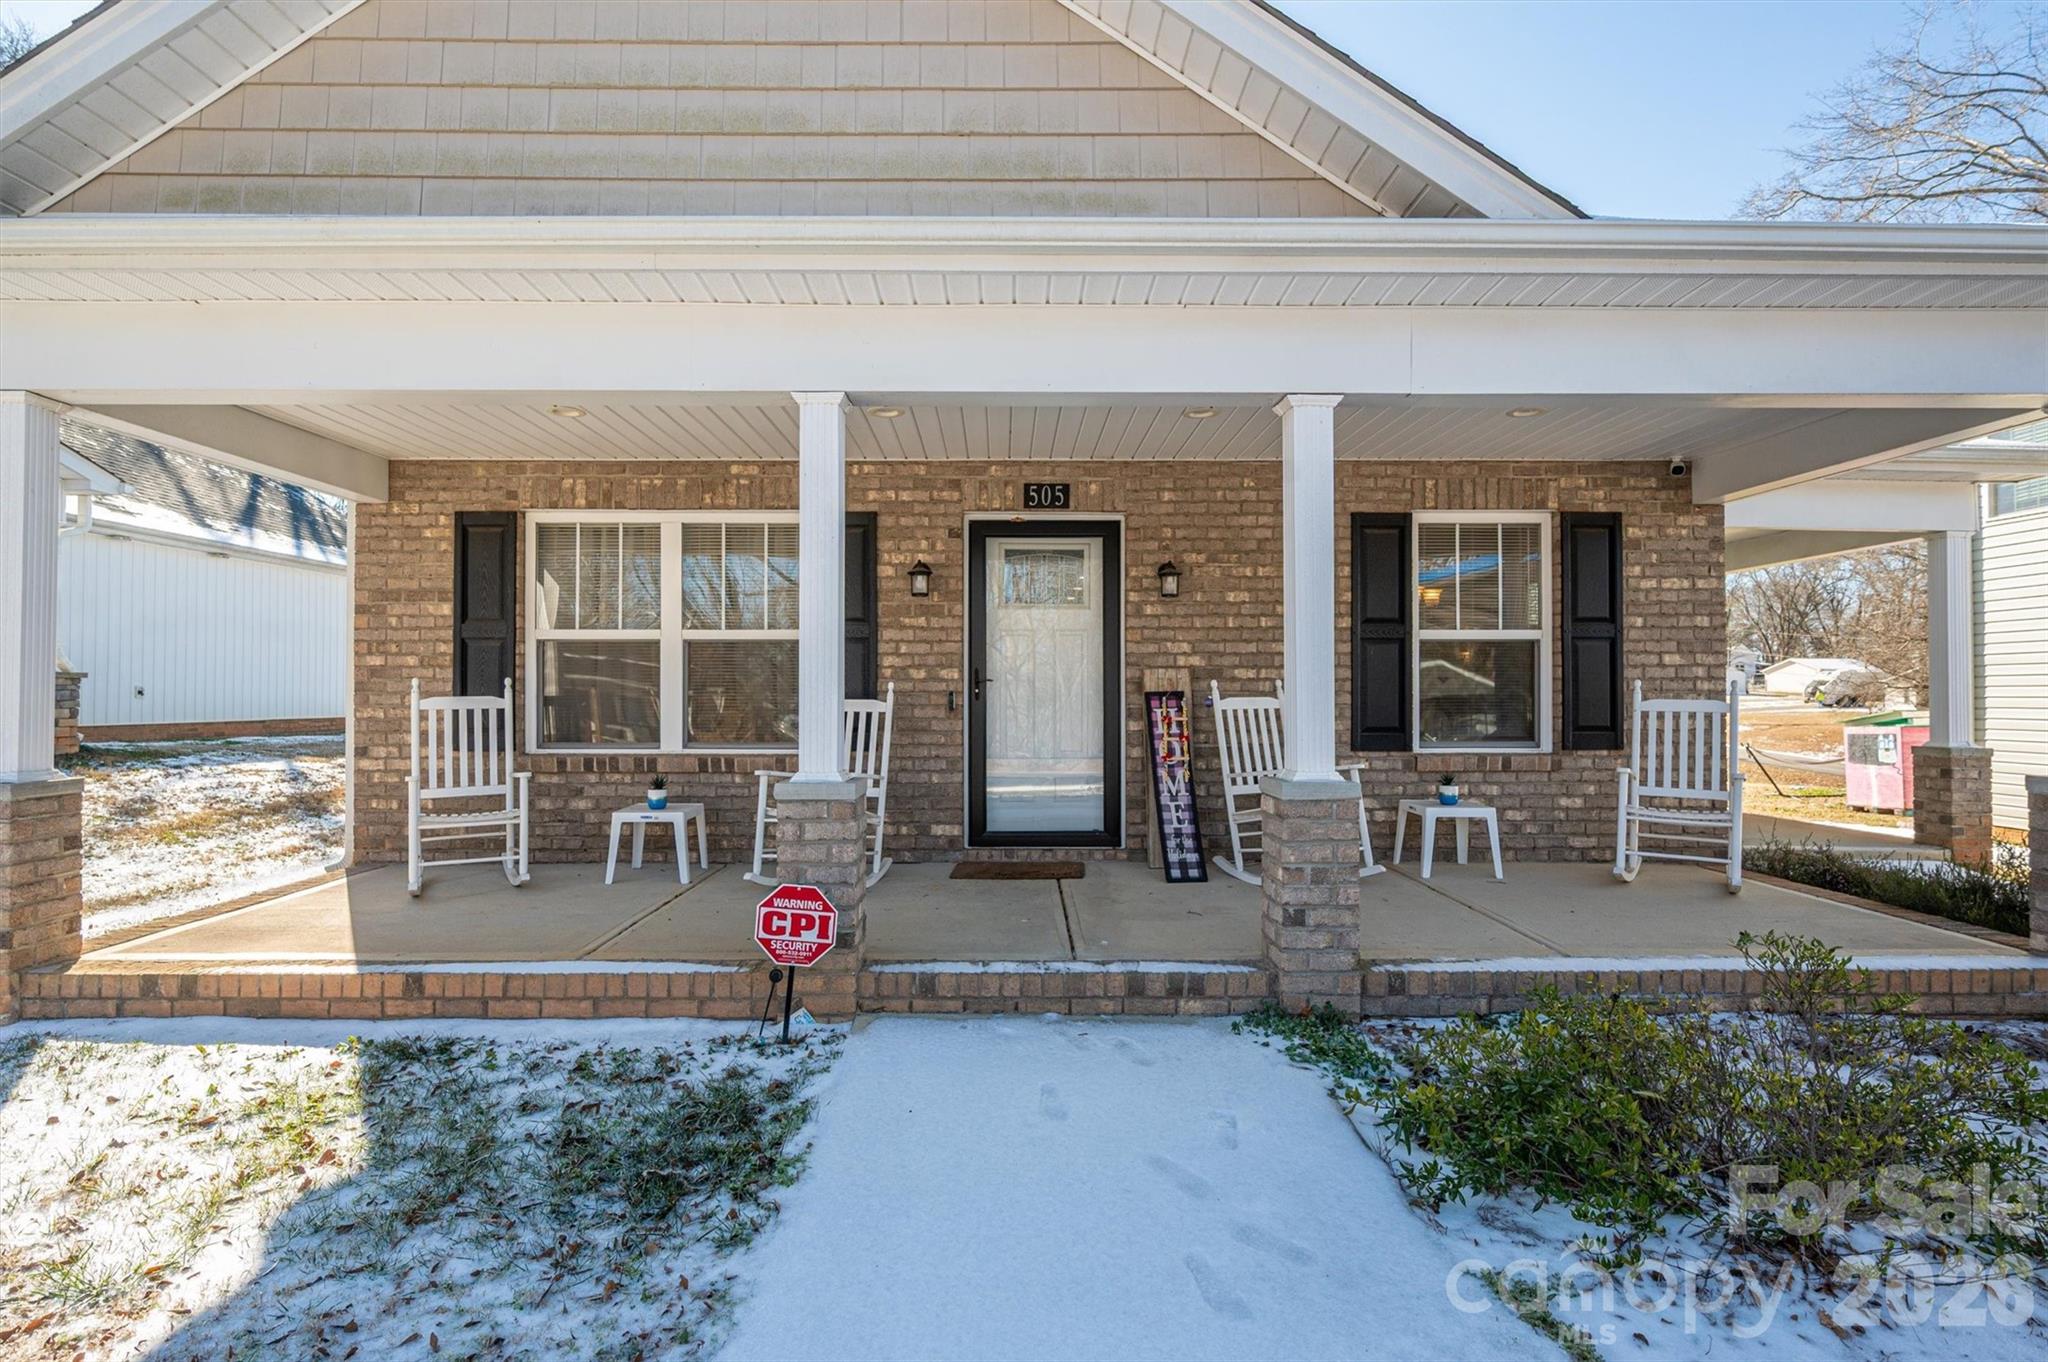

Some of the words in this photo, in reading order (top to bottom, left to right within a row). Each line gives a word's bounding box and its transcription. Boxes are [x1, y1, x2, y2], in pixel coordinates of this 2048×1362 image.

[1029, 485, 1064, 506] 505
[1153, 708, 1190, 827] HOME
[773, 898, 823, 910] WARNING
[762, 911, 831, 939] CPI
[770, 940, 817, 951] SECURITY
